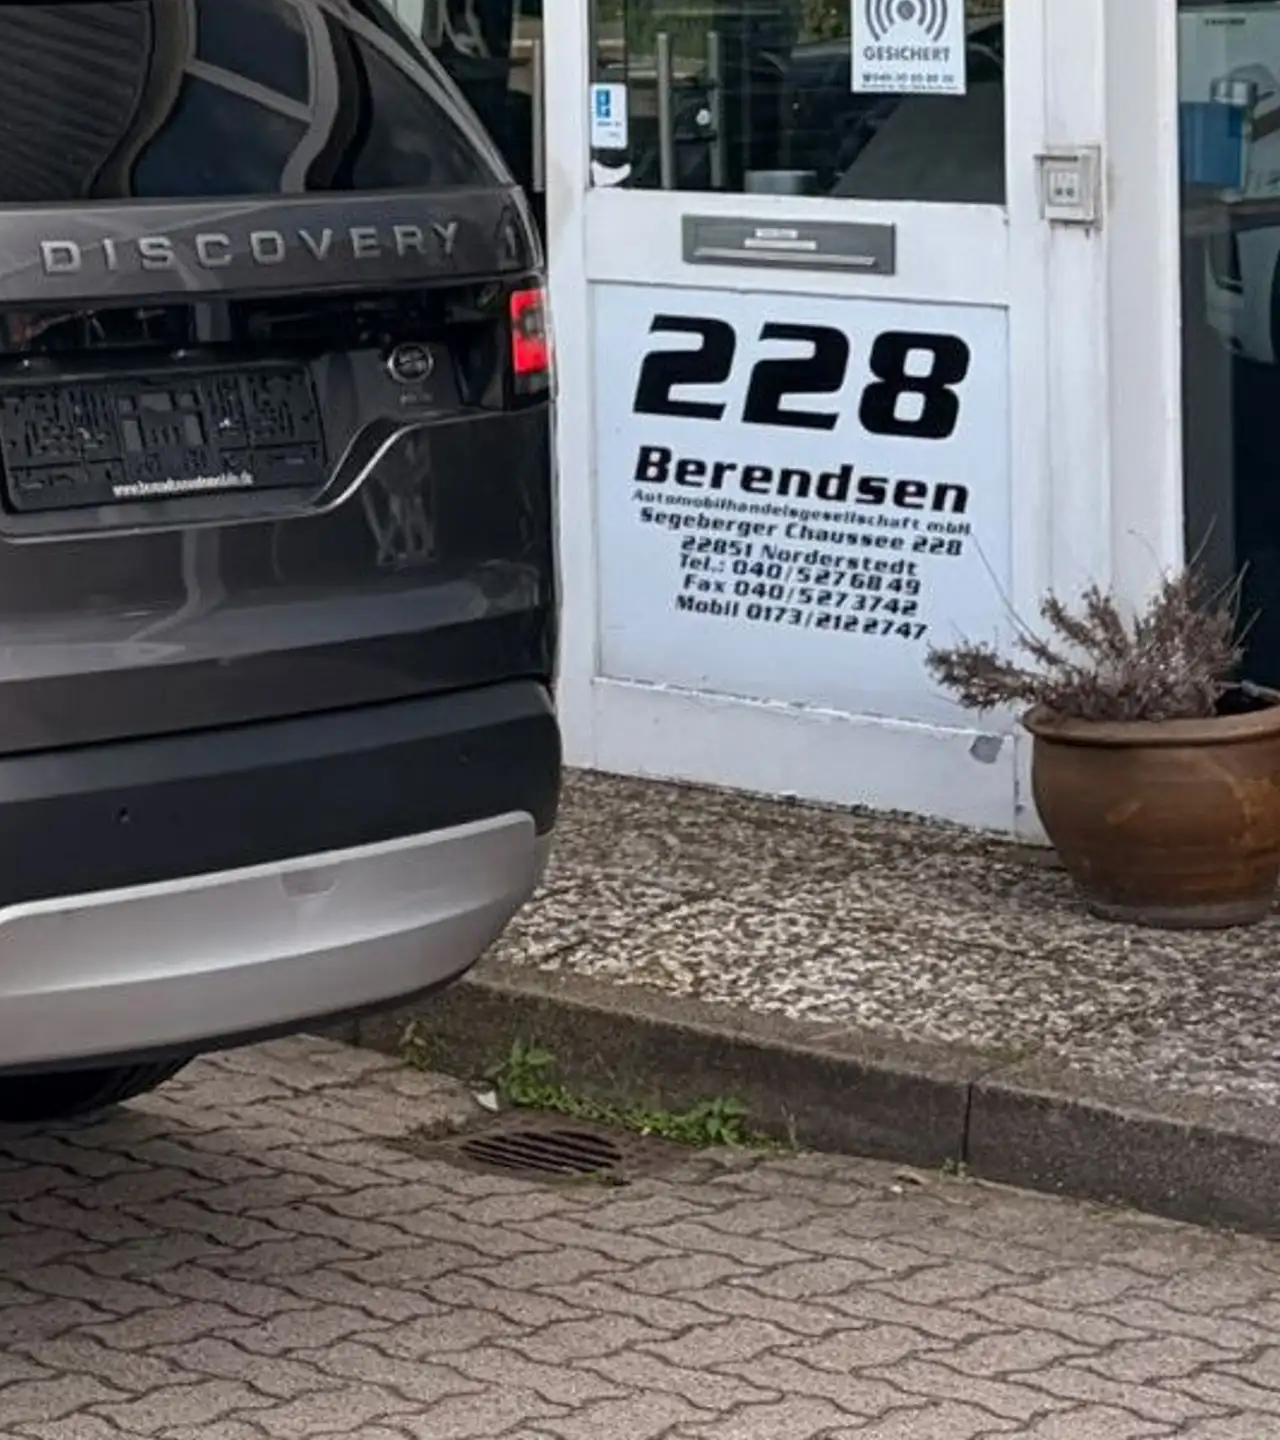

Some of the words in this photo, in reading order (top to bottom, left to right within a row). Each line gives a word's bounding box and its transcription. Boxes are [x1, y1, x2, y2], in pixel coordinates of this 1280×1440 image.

[862, 45, 951, 63] GESICHERT
[40, 221, 458, 274] DISCOVERY
[632, 313, 971, 440] 228
[634, 444, 969, 514] Berendsen
[631, 487, 921, 529] Automobilhandelsgesellschaft
[640, 506, 778, 537] Segeberger
[785, 521, 905, 550] Chaussee
[912, 534, 963, 556] 228
[681, 534, 753, 558] 22851
[760, 543, 920, 577] Norderstedt
[682, 572, 726, 594] Fax
[675, 593, 740, 618] Mobil
